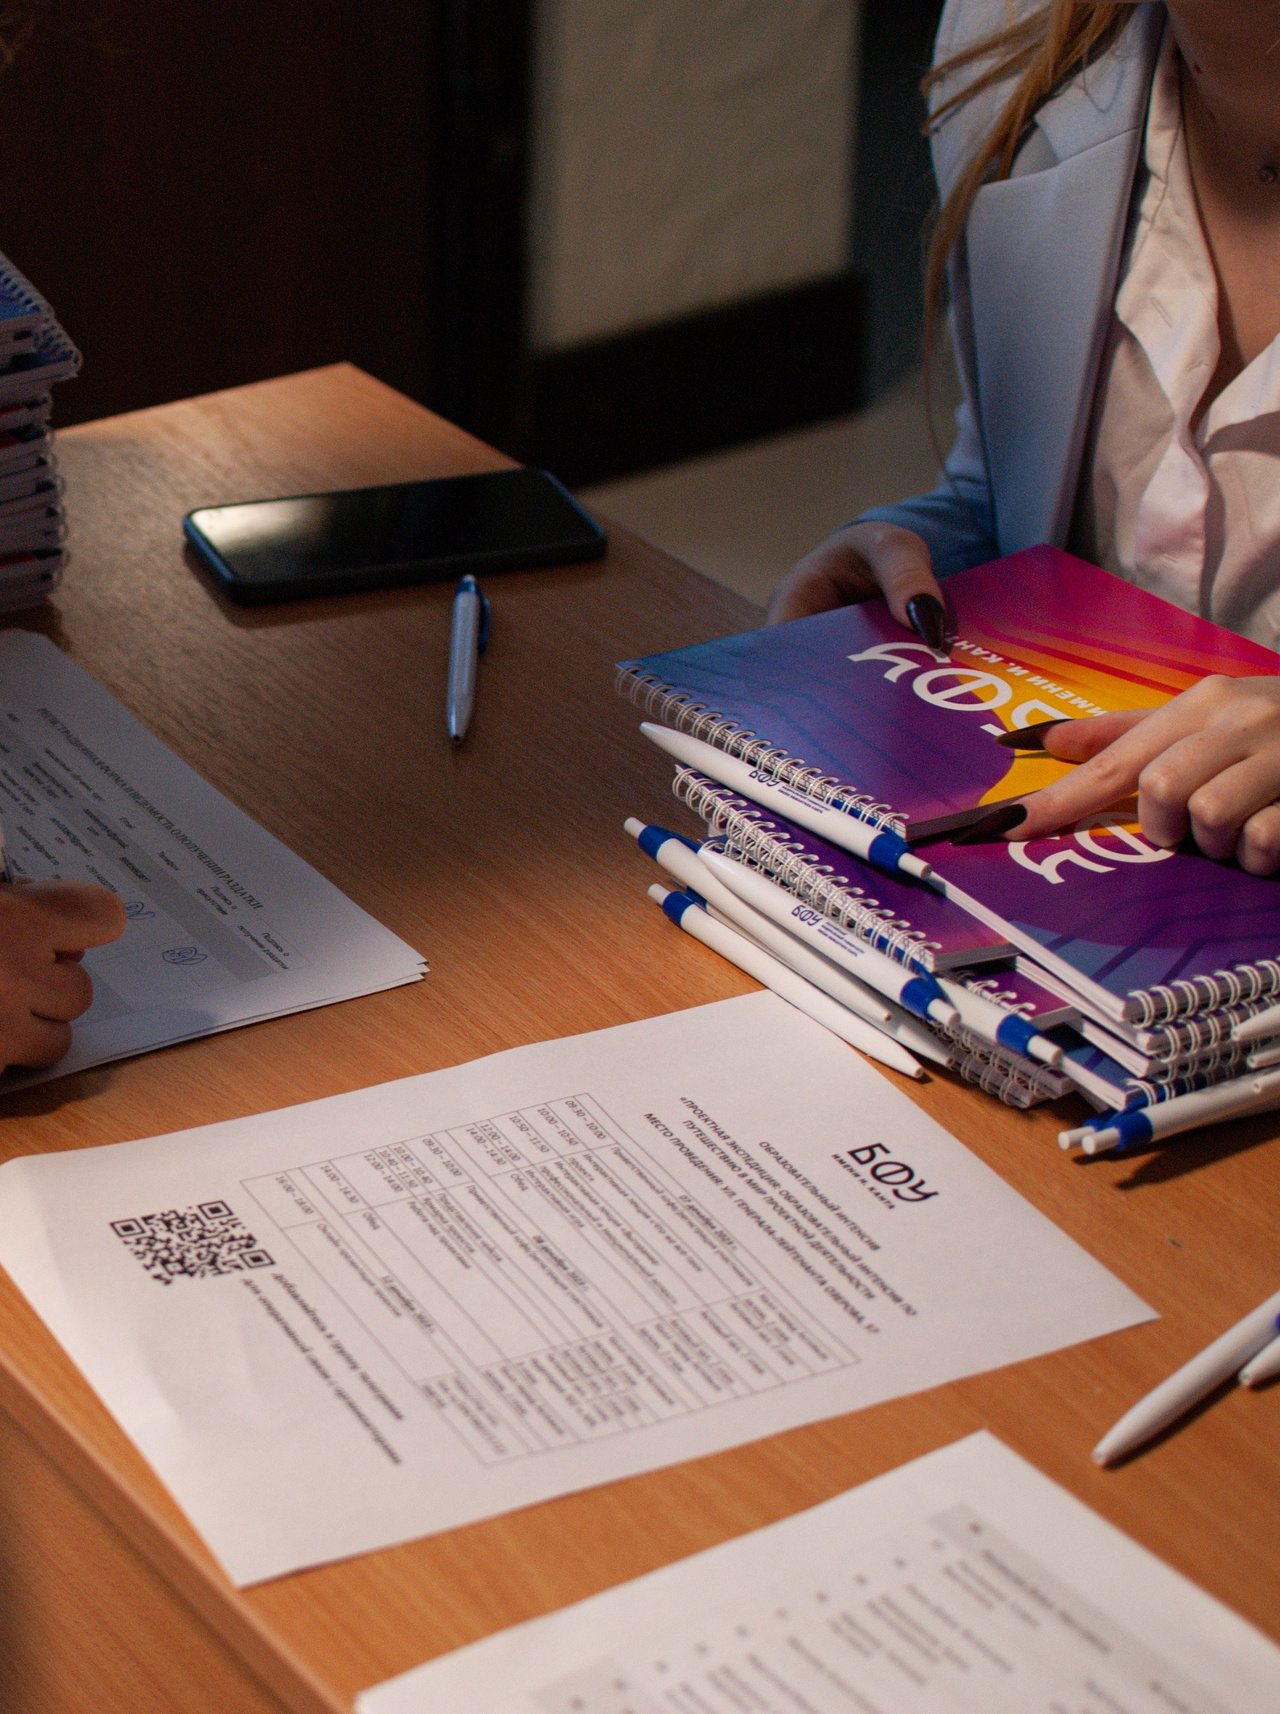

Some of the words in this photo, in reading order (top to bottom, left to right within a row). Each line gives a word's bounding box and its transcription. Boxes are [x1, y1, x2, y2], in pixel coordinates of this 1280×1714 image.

[944, 632, 1005, 663] КАНТ
[1007, 662, 1028, 677] И.
[1026, 674, 1108, 717] ИМЕНИ
[749, 769, 780, 789] БФУ
[791, 904, 821, 927] БФУ
[643, 1113, 674, 1138] МЕСТО
[669, 1137, 724, 1186] ПРОВЕДЕНИЯ:
[720, 1185, 737, 1199] УЛ.
[733, 1198, 828, 1287] ГЕНЕРАЛА-ЛЕЙТЕНАНТА
[679, 1096, 731, 1141] «ПРОЕКТНАЯ
[725, 1140, 781, 1190] ЭКСПЕДИЦИЯ:
[778, 1189, 863, 1263] ОБРАЗОВАТЕЛЬНЫЙ
[857, 1262, 904, 1304] ИНТЕНСИВ
[758, 1141, 841, 1212] ОБРАЗОВАТЕЛЬНЫЙ
[834, 1211, 882, 1252] ИНТЕНСИВ
[831, 1153, 861, 1178] ИМЕНИ
[867, 1186, 896, 1210] КАНТА
[846, 1142, 940, 1203] БФУ
[681, 1119, 742, 1172] ПУТЕШЕСТВИЮ
[744, 1178, 768, 1196] МИР
[762, 1195, 816, 1241] ПРОЕКТНОЙ
[807, 1240, 876, 1300] ДЕЯТЕЛЬНОСТИ
